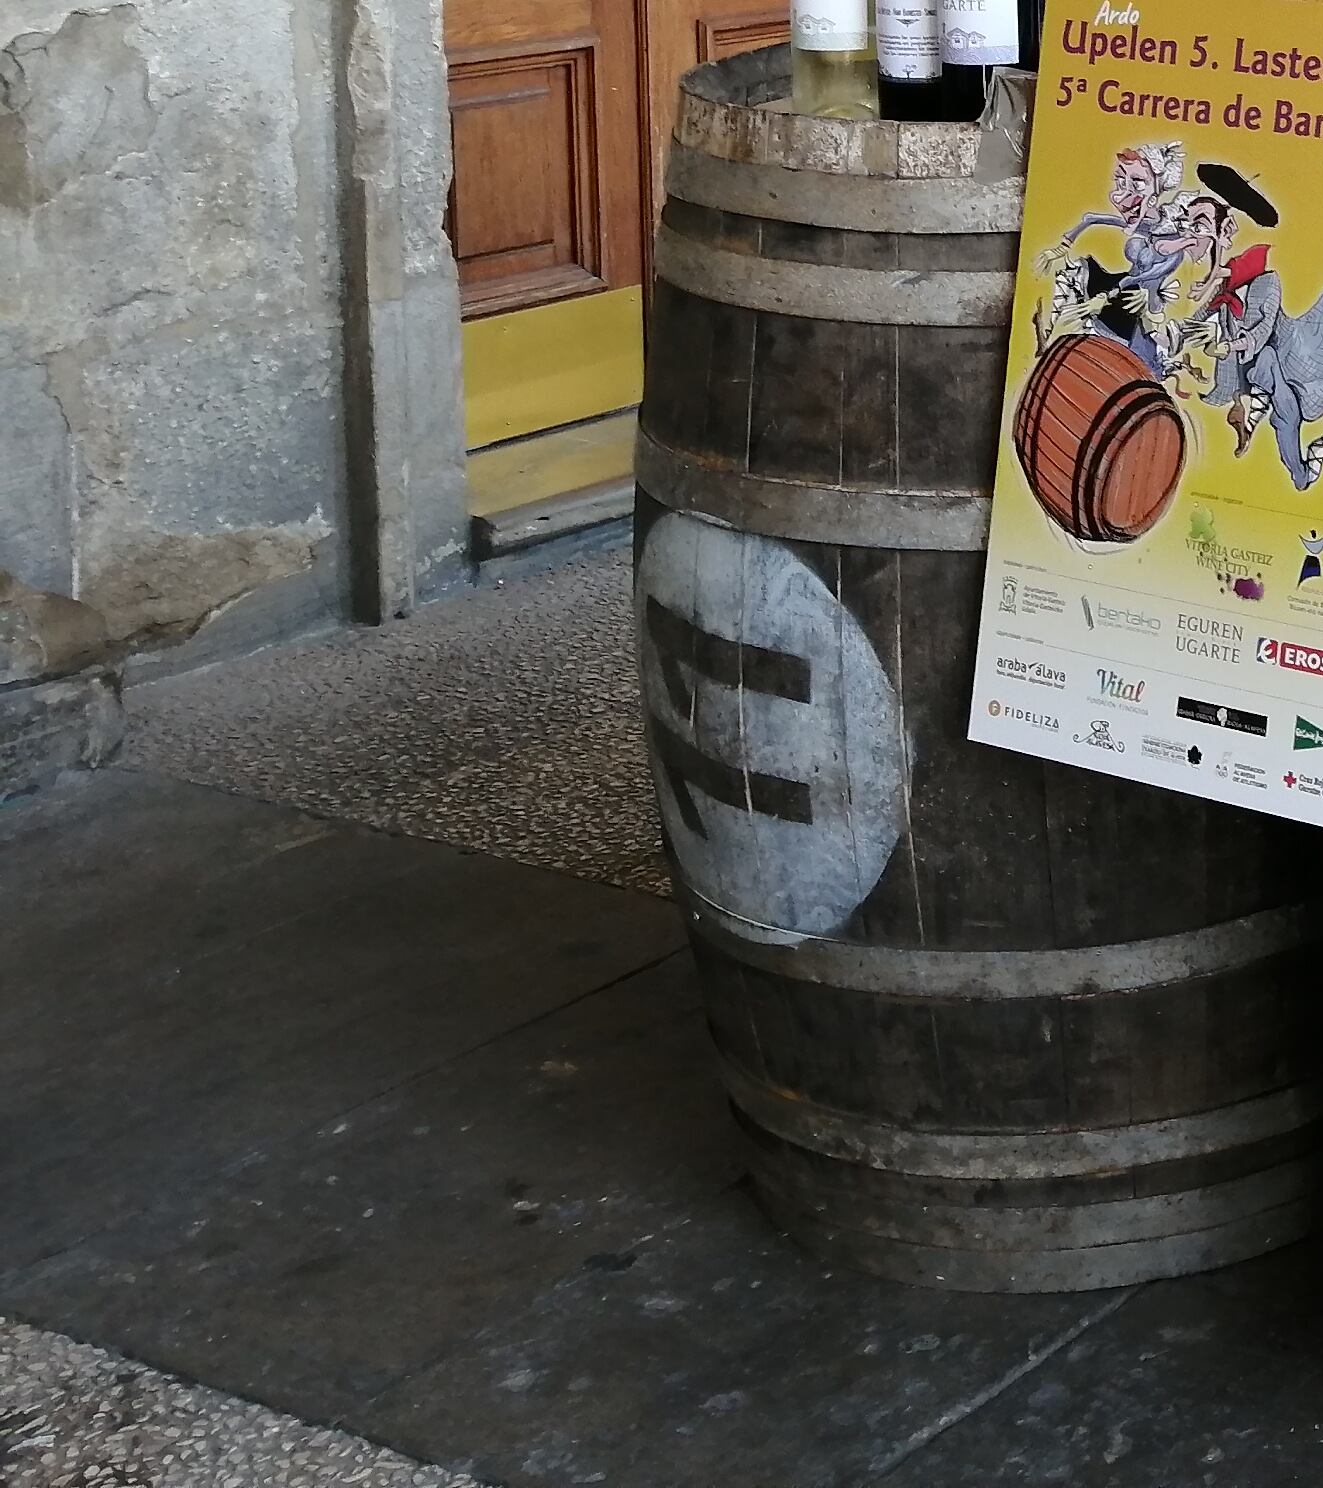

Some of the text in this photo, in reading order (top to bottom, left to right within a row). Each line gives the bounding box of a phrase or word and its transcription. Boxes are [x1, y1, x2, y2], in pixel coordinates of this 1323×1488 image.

[1094, 0, 1140, 26] Ardo
[1062, 19, 1177, 65] Upelen
[1189, 35, 1219, 70] 5.
[1056, 76, 1088, 107] 5ª
[1098, 80, 1211, 124] Carrera
[1223, 94, 1262, 131] de
[1230, 548, 1274, 566] GASTEIZ
[1098, 601, 1161, 630] bertako
[1177, 614, 1245, 642] EGUREN
[1175, 636, 1242, 664] UGARTE
[996, 656, 1028, 673] araba
[1035, 663, 1067, 683] álava
[1096, 668, 1146, 703] Vital
[1004, 706, 1060, 729] FIDELIZA
